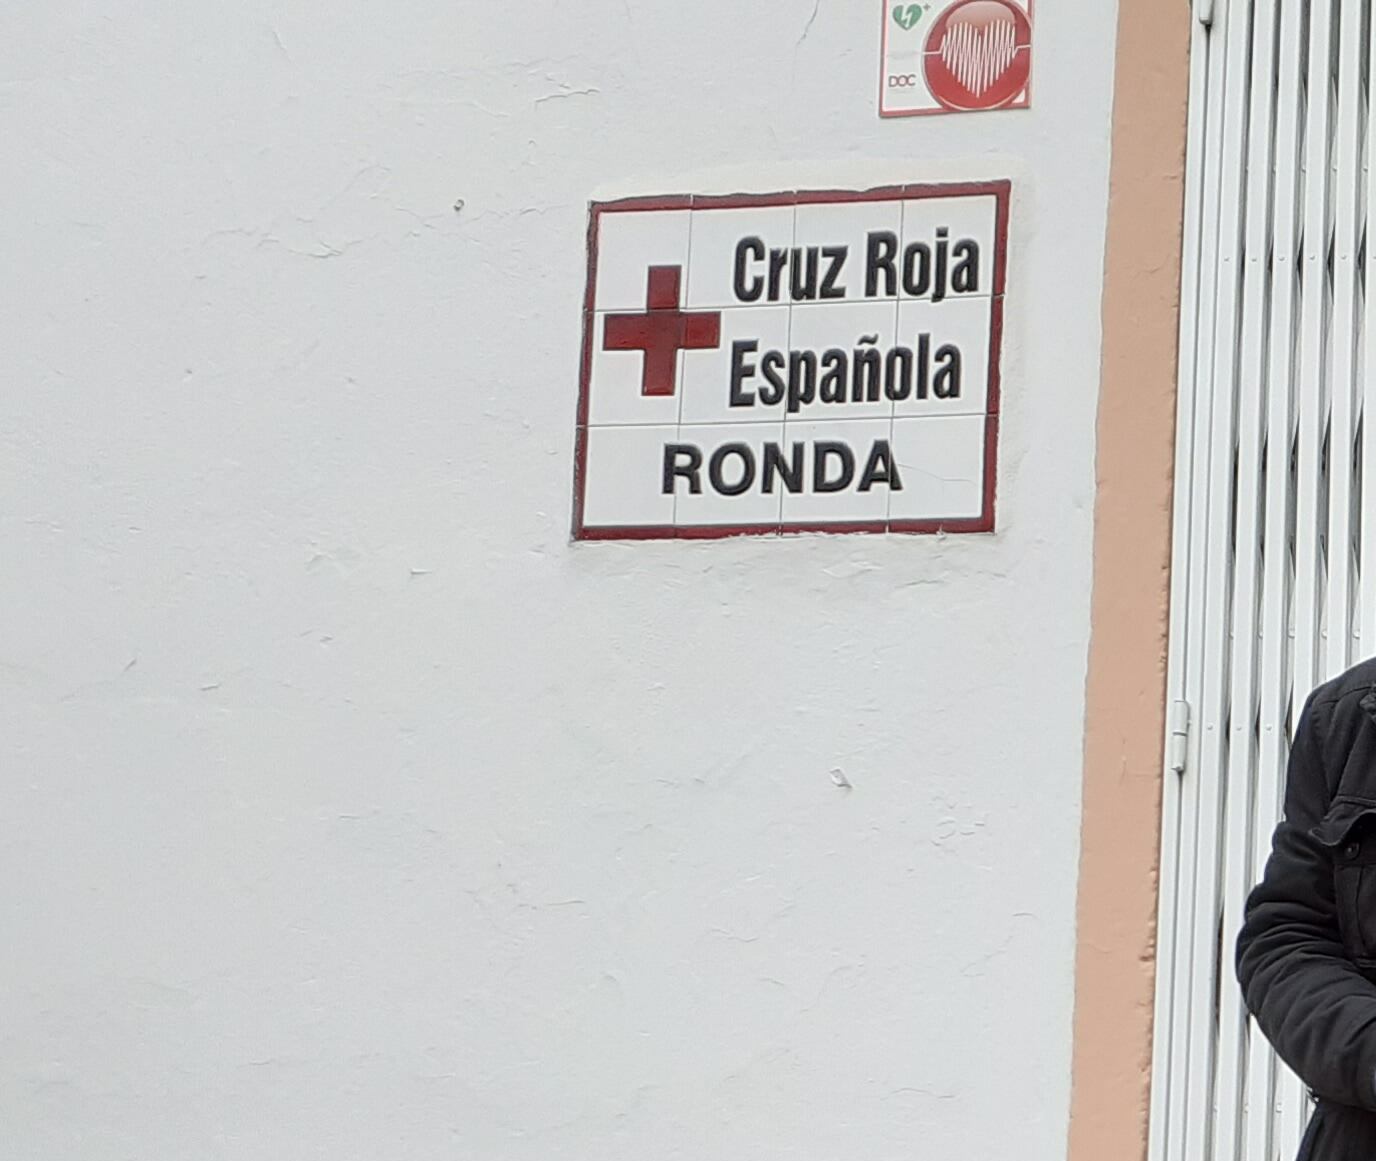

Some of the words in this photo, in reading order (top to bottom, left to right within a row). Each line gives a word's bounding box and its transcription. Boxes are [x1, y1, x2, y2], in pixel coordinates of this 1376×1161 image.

[889, 74, 917, 88] DOC
[733, 235, 849, 302] Cruz
[864, 226, 980, 303] Roja
[728, 333, 962, 414] Española
[661, 439, 904, 497] RONDA
